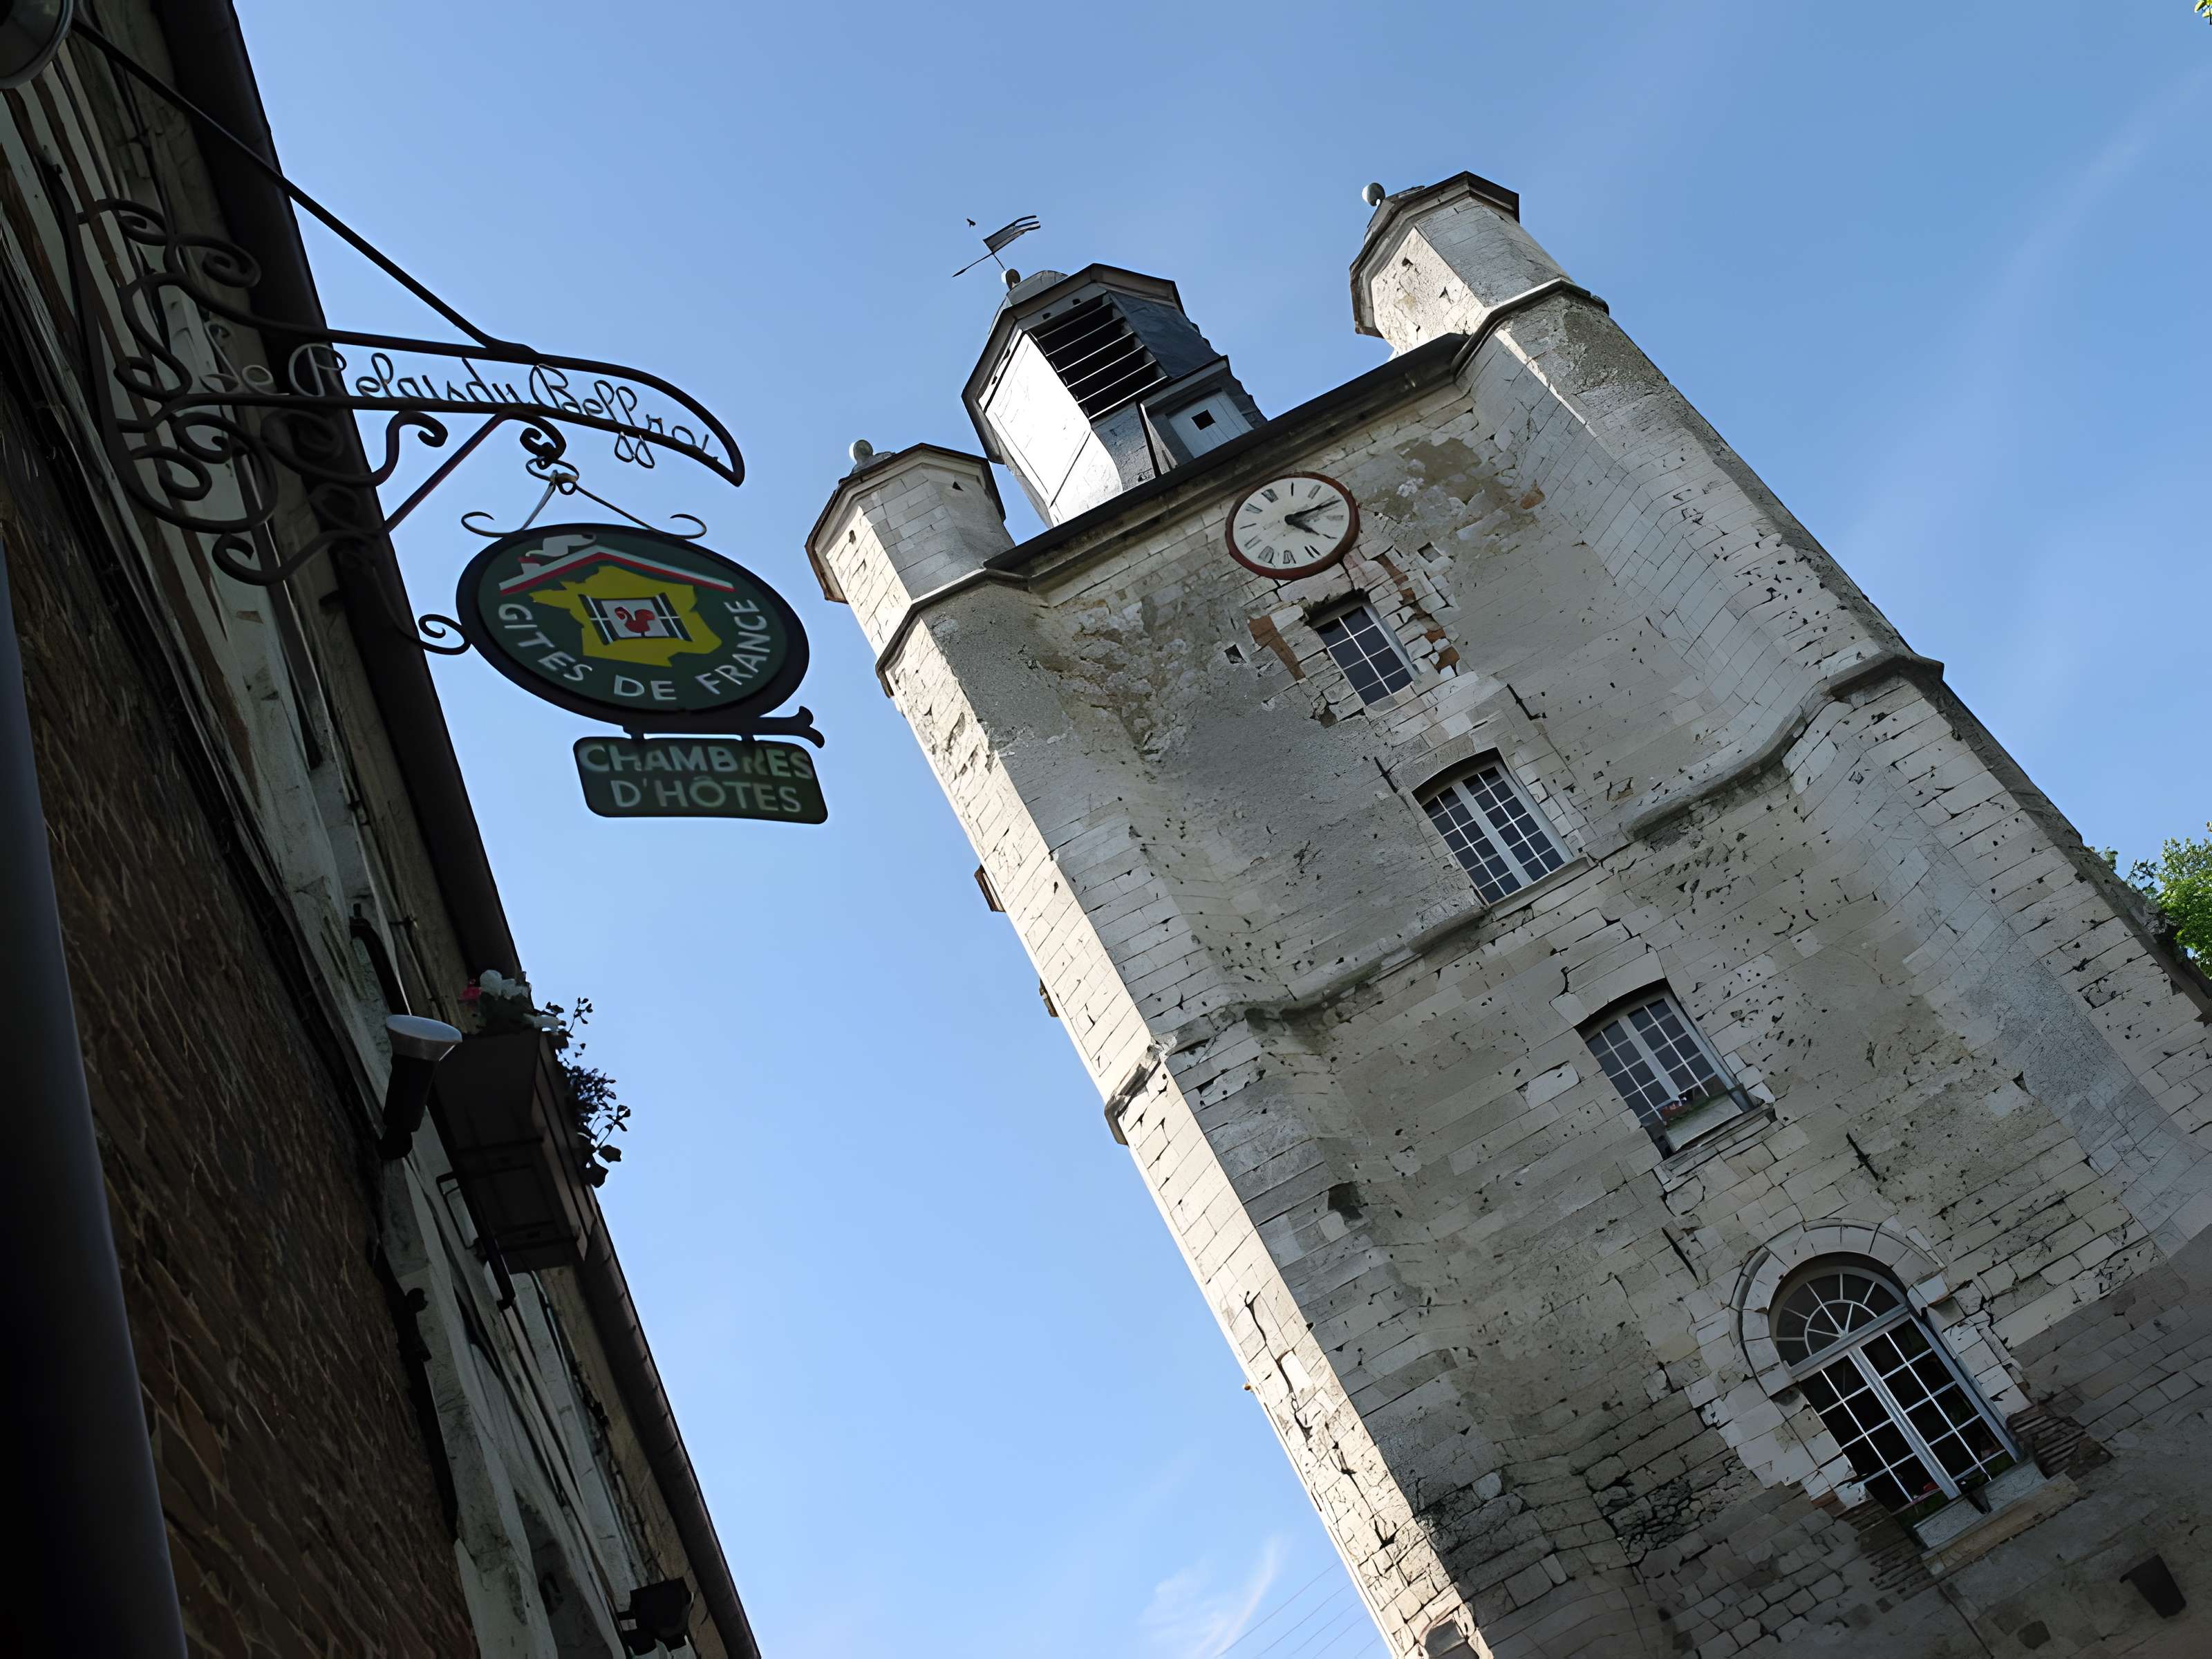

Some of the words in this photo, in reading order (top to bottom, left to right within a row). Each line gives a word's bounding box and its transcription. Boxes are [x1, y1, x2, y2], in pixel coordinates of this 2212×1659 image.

[288, 343, 468, 401] Relais
[461, 357, 525, 404] du
[498, 603, 592, 682] GITES
[614, 675, 677, 700] DE
[694, 599, 771, 694] FRANCE
[610, 776, 802, 812] D'HÔTES
